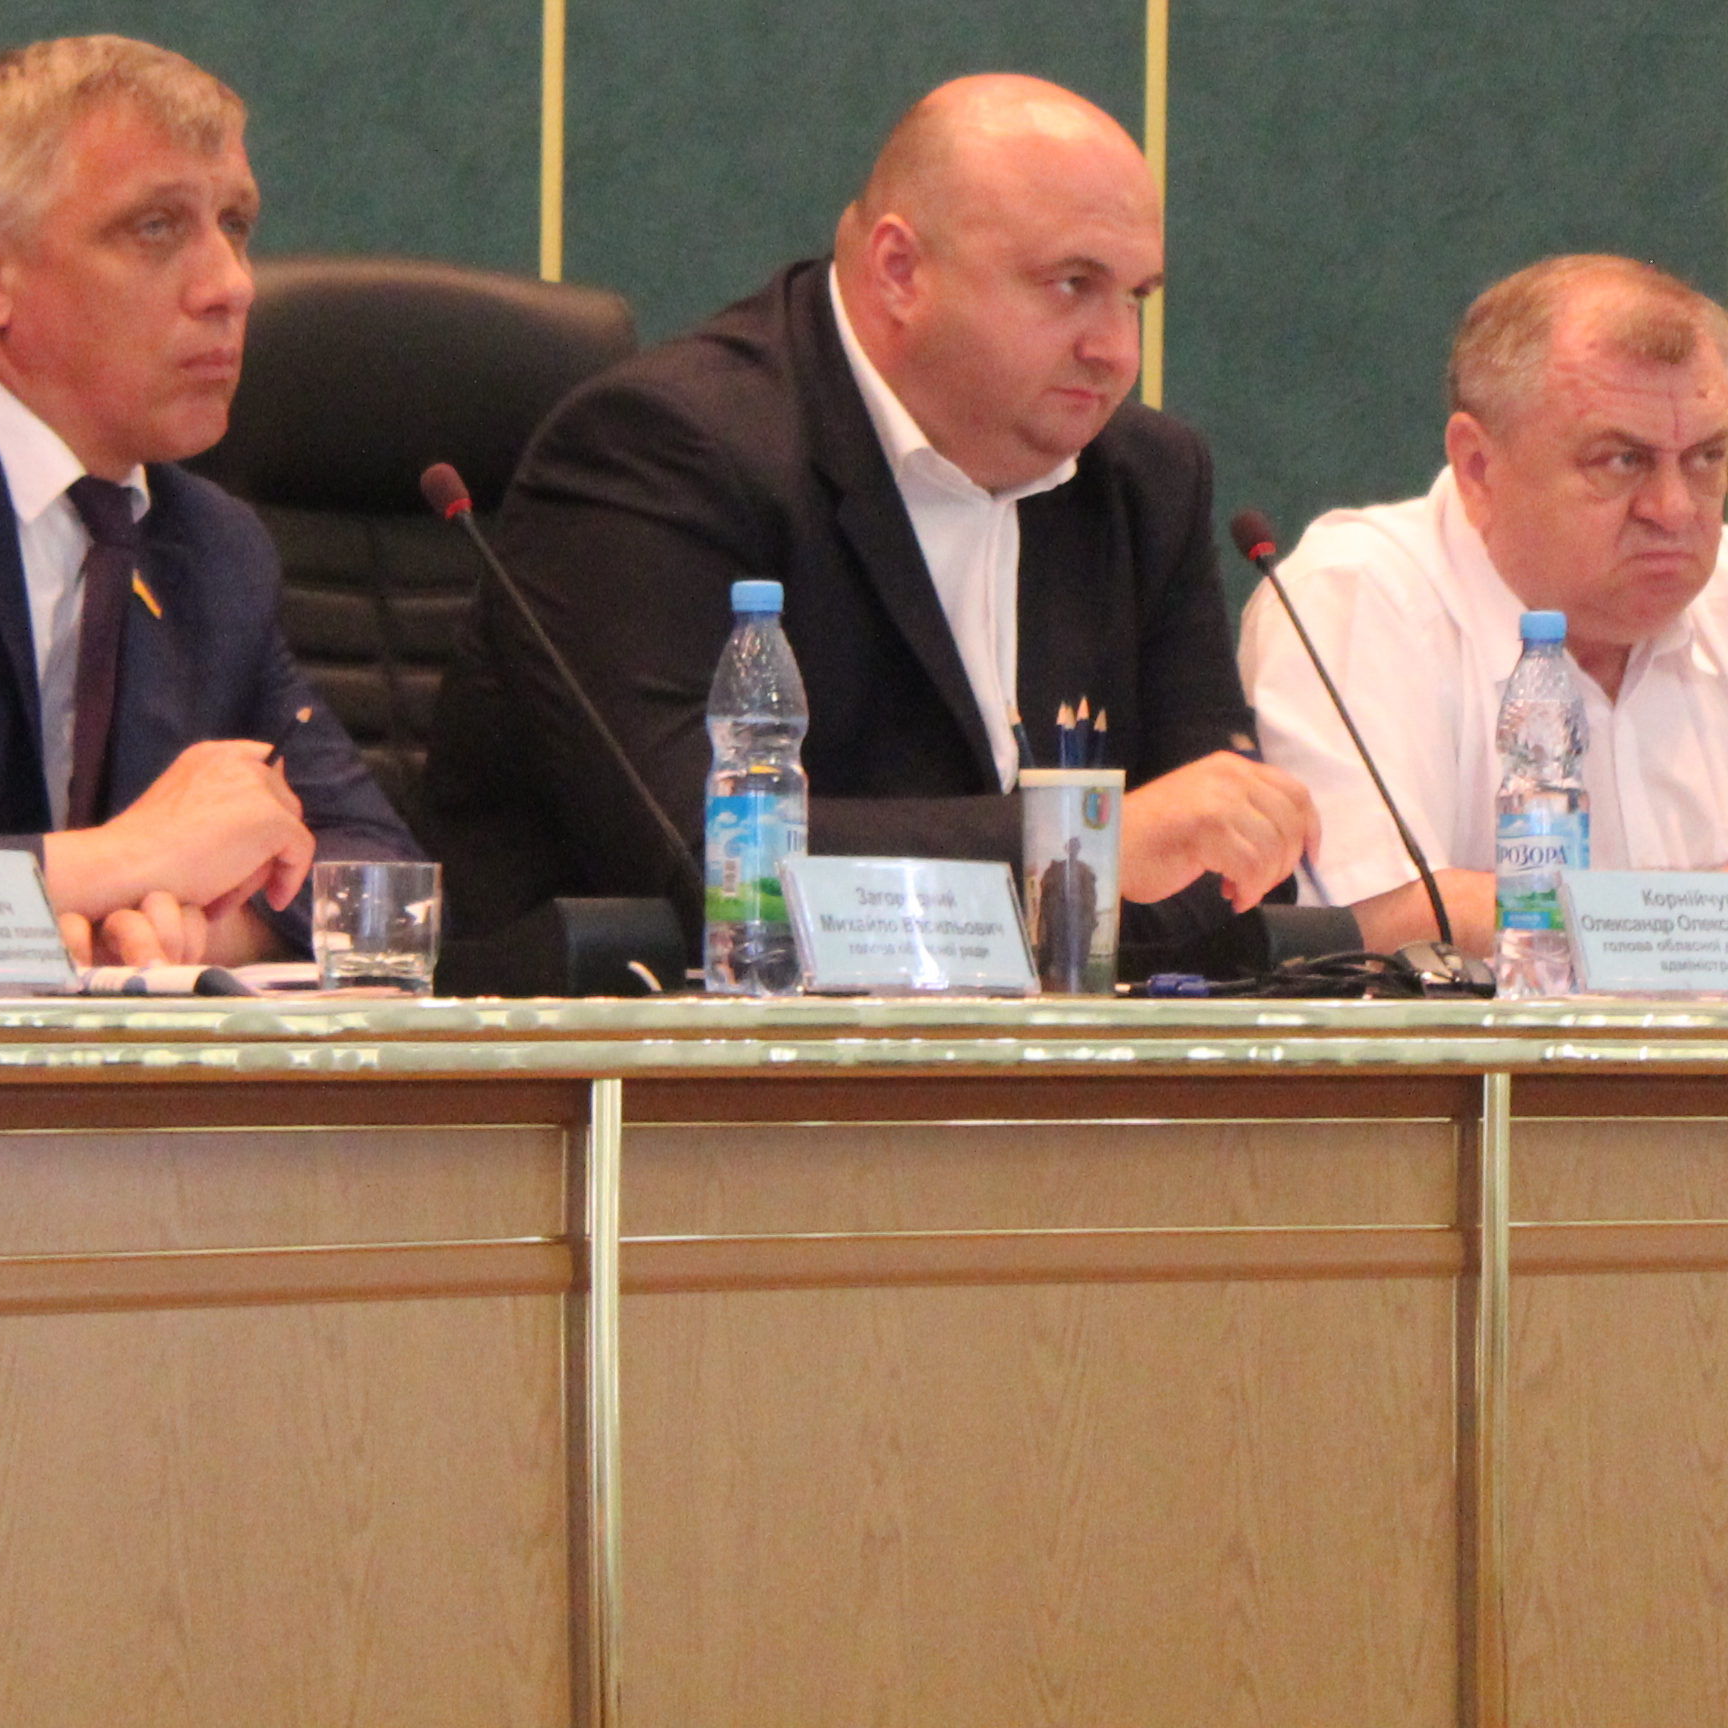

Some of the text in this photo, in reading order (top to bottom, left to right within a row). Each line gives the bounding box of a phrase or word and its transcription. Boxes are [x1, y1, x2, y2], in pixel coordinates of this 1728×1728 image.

[820, 913, 898, 933] Михайло
[1581, 915, 1674, 934] Олександр
[1603, 940, 1653, 953] голова
